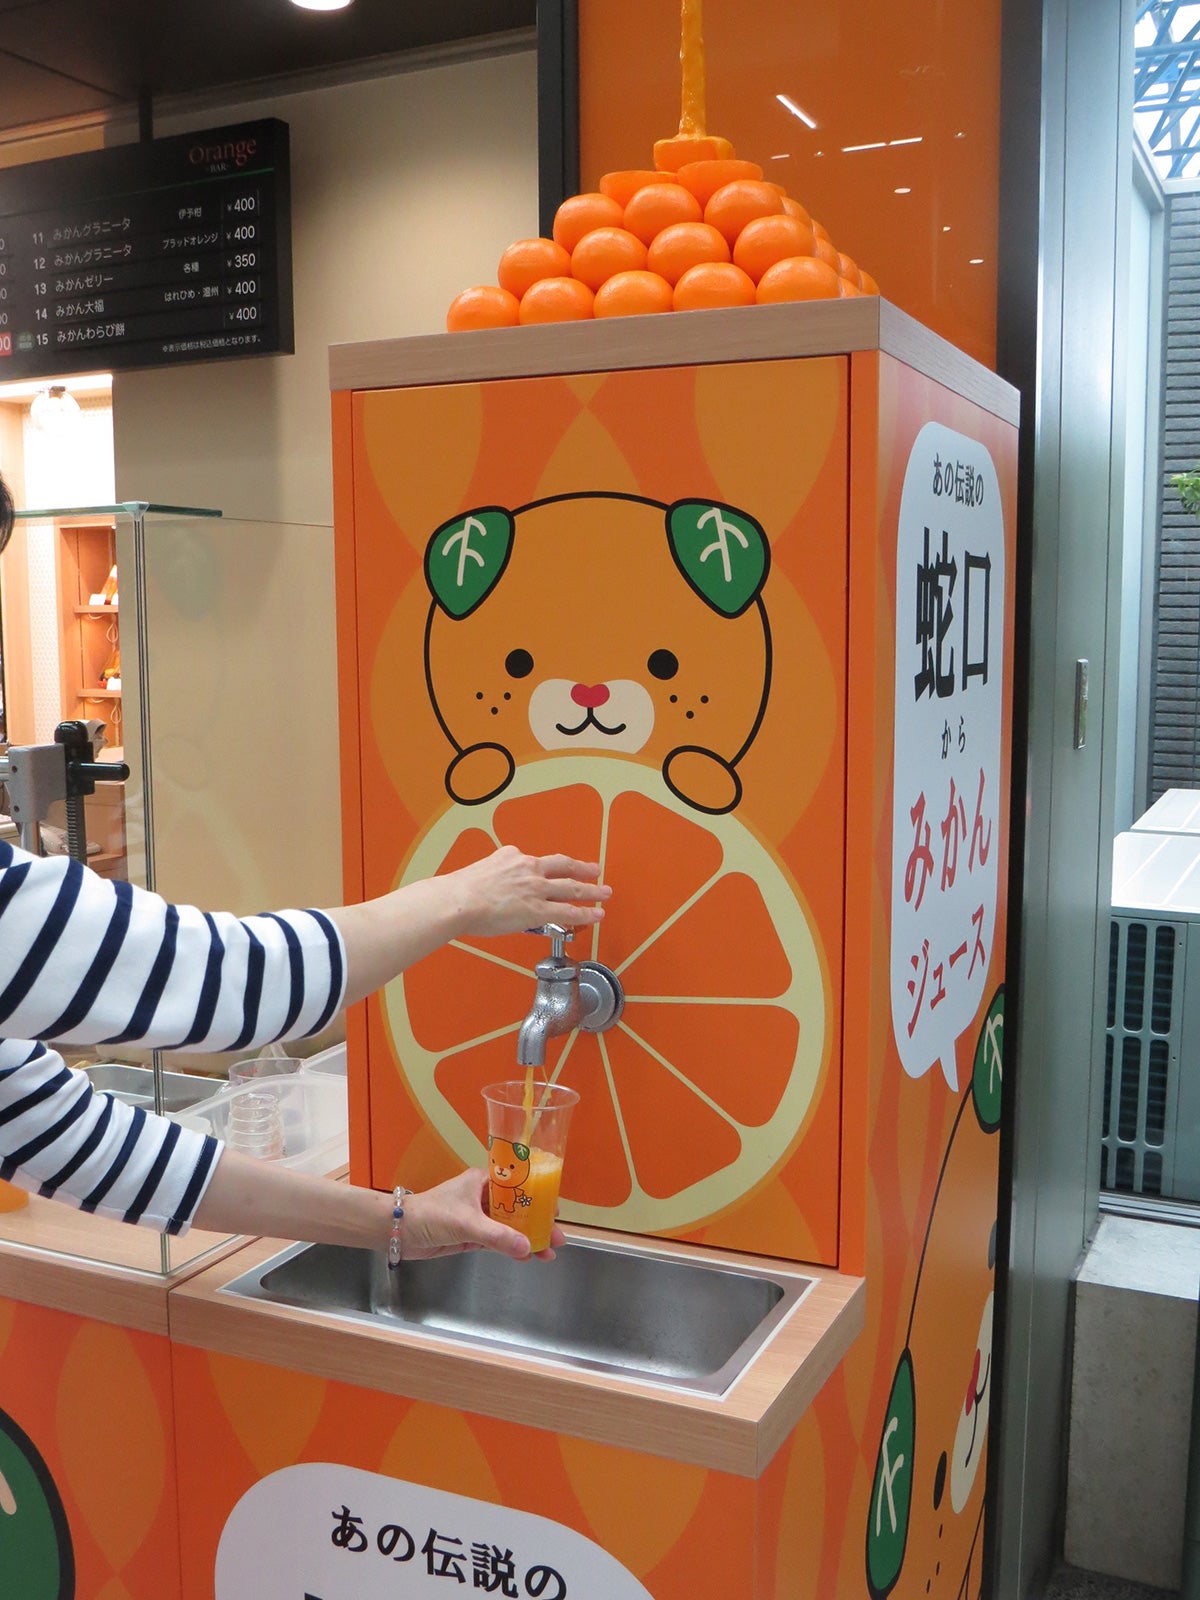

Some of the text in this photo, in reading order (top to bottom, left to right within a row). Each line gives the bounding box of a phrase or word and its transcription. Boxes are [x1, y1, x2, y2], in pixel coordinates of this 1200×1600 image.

[188, 138, 257, 166] Orange
[33, 231, 44, 245] 11
[53, 217, 131, 241] みかんグラニータ
[226, 196, 256, 213] ¥400
[33, 256, 46, 271] 12
[54, 243, 132, 267] みかんグラニータ
[226, 225, 256, 241] ¥400
[34, 282, 47, 296] 13
[55, 274, 113, 293] みかんゼリー
[226, 252, 256, 268] ¥350
[35, 307, 48, 321] 14
[55, 299, 105, 318] みかん大福
[227, 279, 257, 295] ¥400
[36, 332, 49, 346] 15
[57, 322, 126, 344] みかんわらび餅
[228, 306, 258, 321] ¥400
[932, 452, 984, 508] あの伝説の
[914, 526, 992, 703] 蛇口
[941, 716, 967, 760] から
[904, 766, 992, 913] みかん
[907, 903, 986, 1040] ジュース
[330, 1504, 568, 1600] あの伝説の
